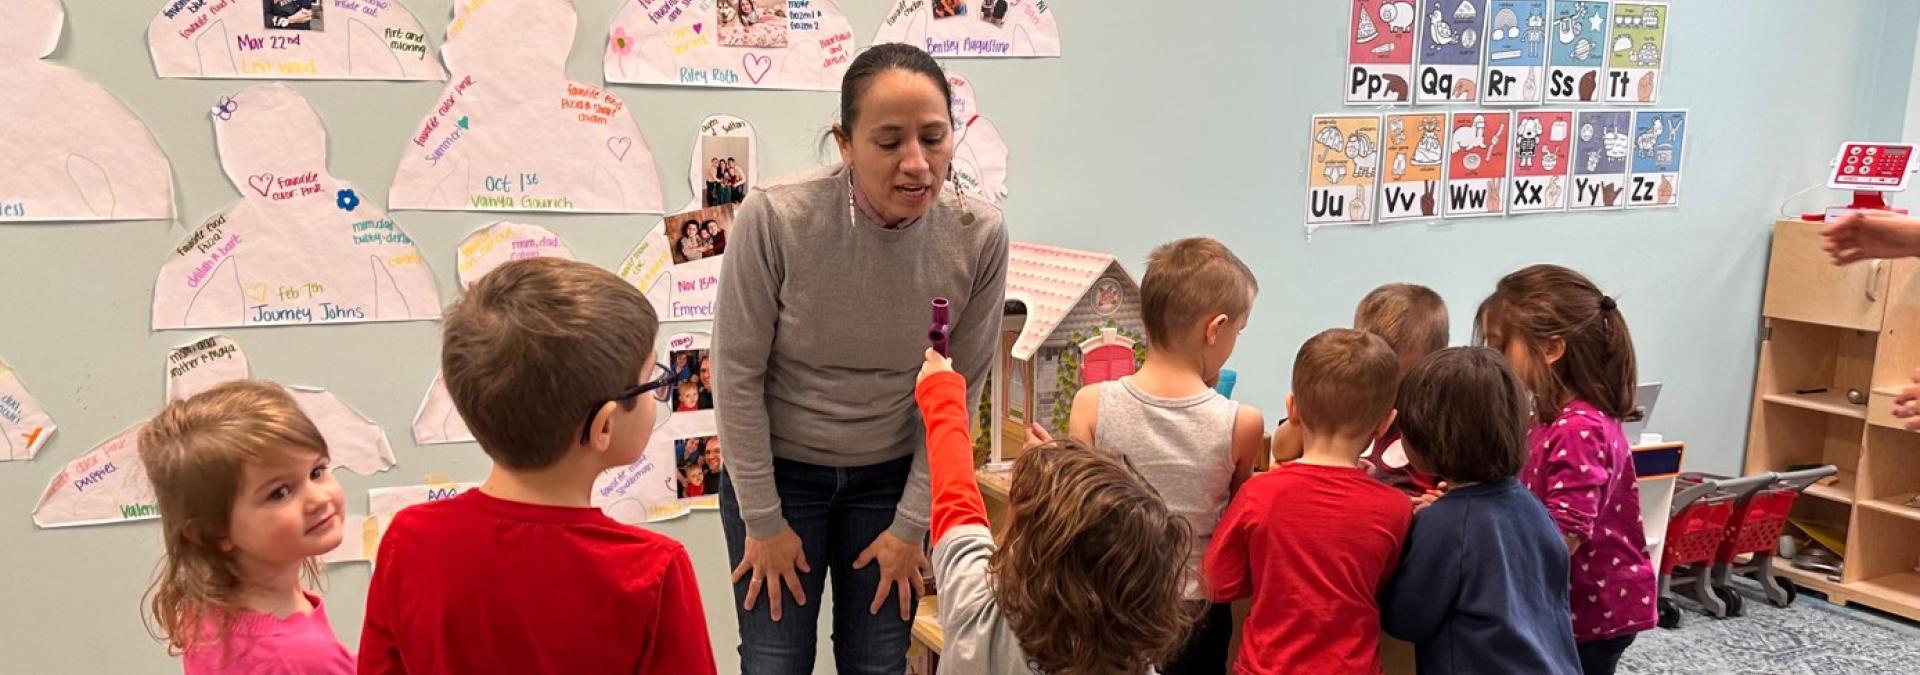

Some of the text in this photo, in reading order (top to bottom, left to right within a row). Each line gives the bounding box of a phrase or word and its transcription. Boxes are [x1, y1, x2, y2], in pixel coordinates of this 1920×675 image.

[1351, 66, 1381, 99] Pp
[1421, 67, 1452, 99] Qq
[1488, 69, 1516, 97] Rr
[1550, 70, 1574, 96] Ss
[1610, 71, 1630, 97] Tt
[485, 173, 540, 193] Oct 1st
[1514, 179, 1543, 205] Xx
[1576, 178, 1600, 205] Yy
[1631, 176, 1654, 201] Zz
[1311, 189, 1344, 218] Uu
[1385, 186, 1415, 213] Vv
[1449, 184, 1486, 210] Ww
[250, 302, 365, 323] Journey Johns
